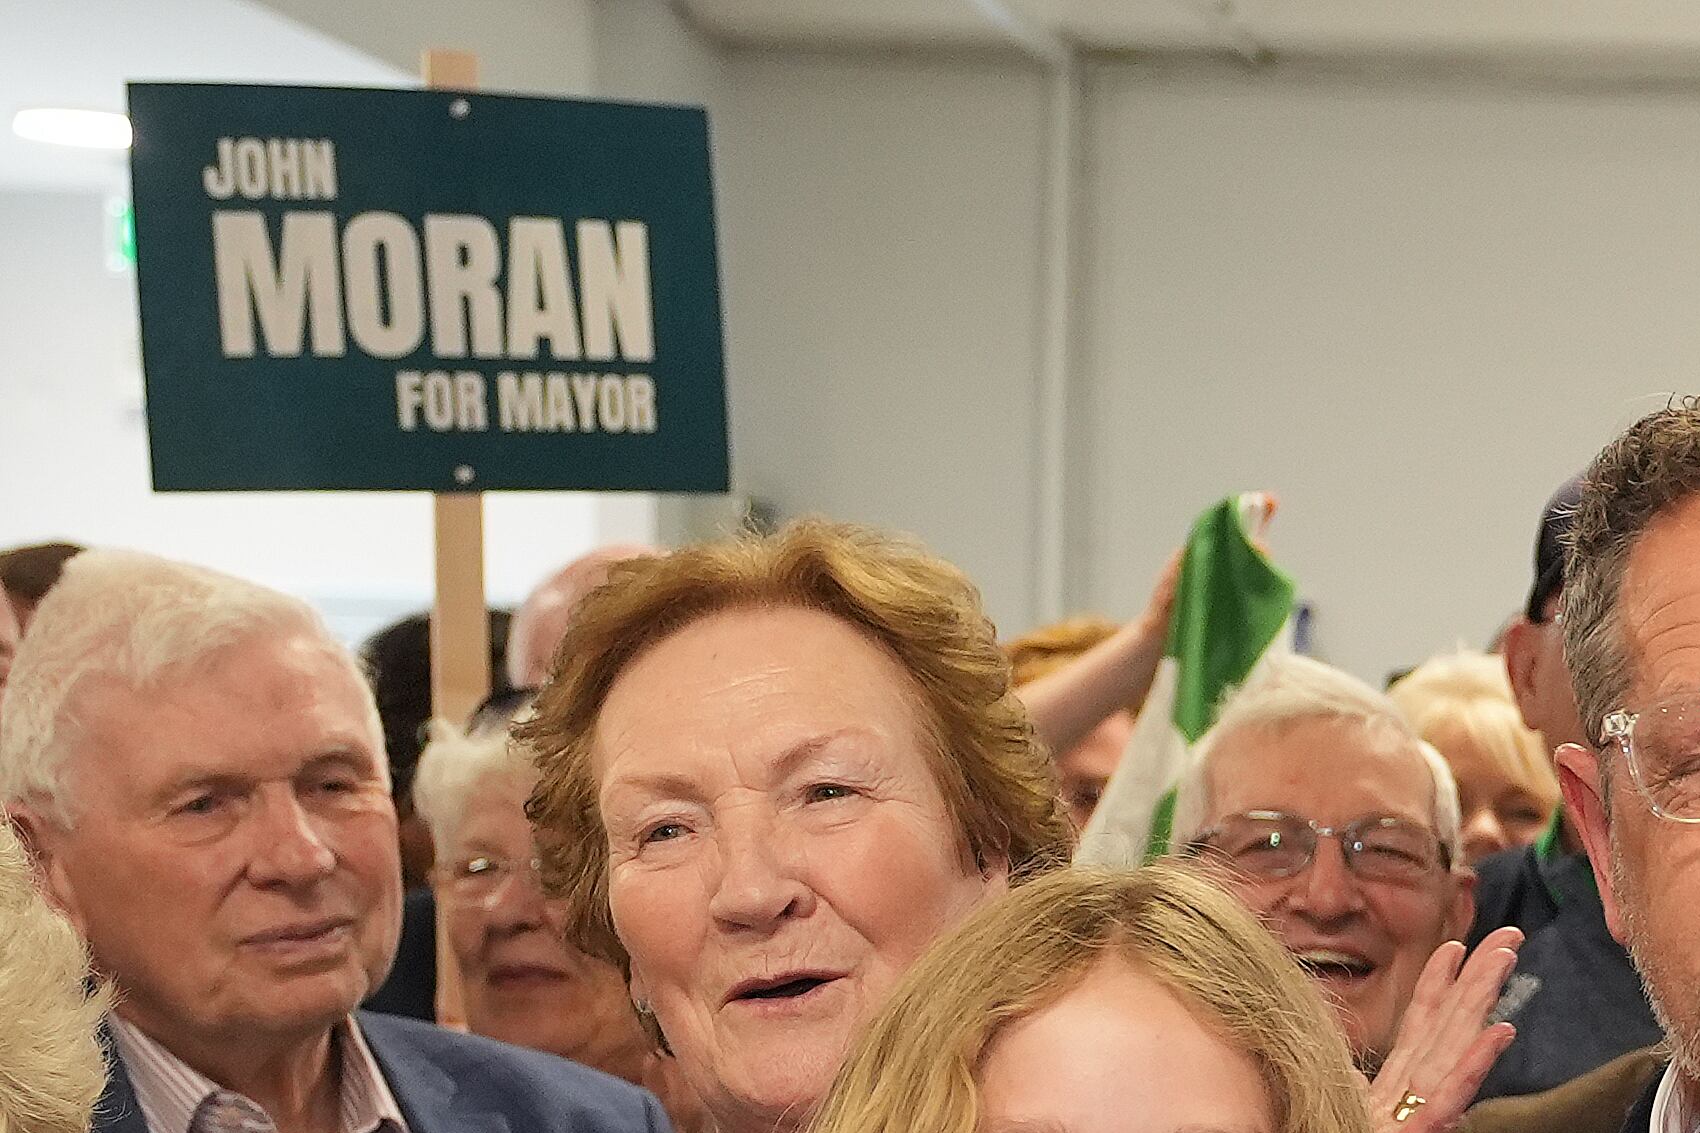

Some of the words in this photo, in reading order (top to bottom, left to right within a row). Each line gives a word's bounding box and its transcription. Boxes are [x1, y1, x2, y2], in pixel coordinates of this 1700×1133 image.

[203, 137, 338, 200] JOHN
[211, 210, 655, 362] MORAN
[396, 370, 488, 432] FOR
[497, 372, 657, 434] MAYOR
